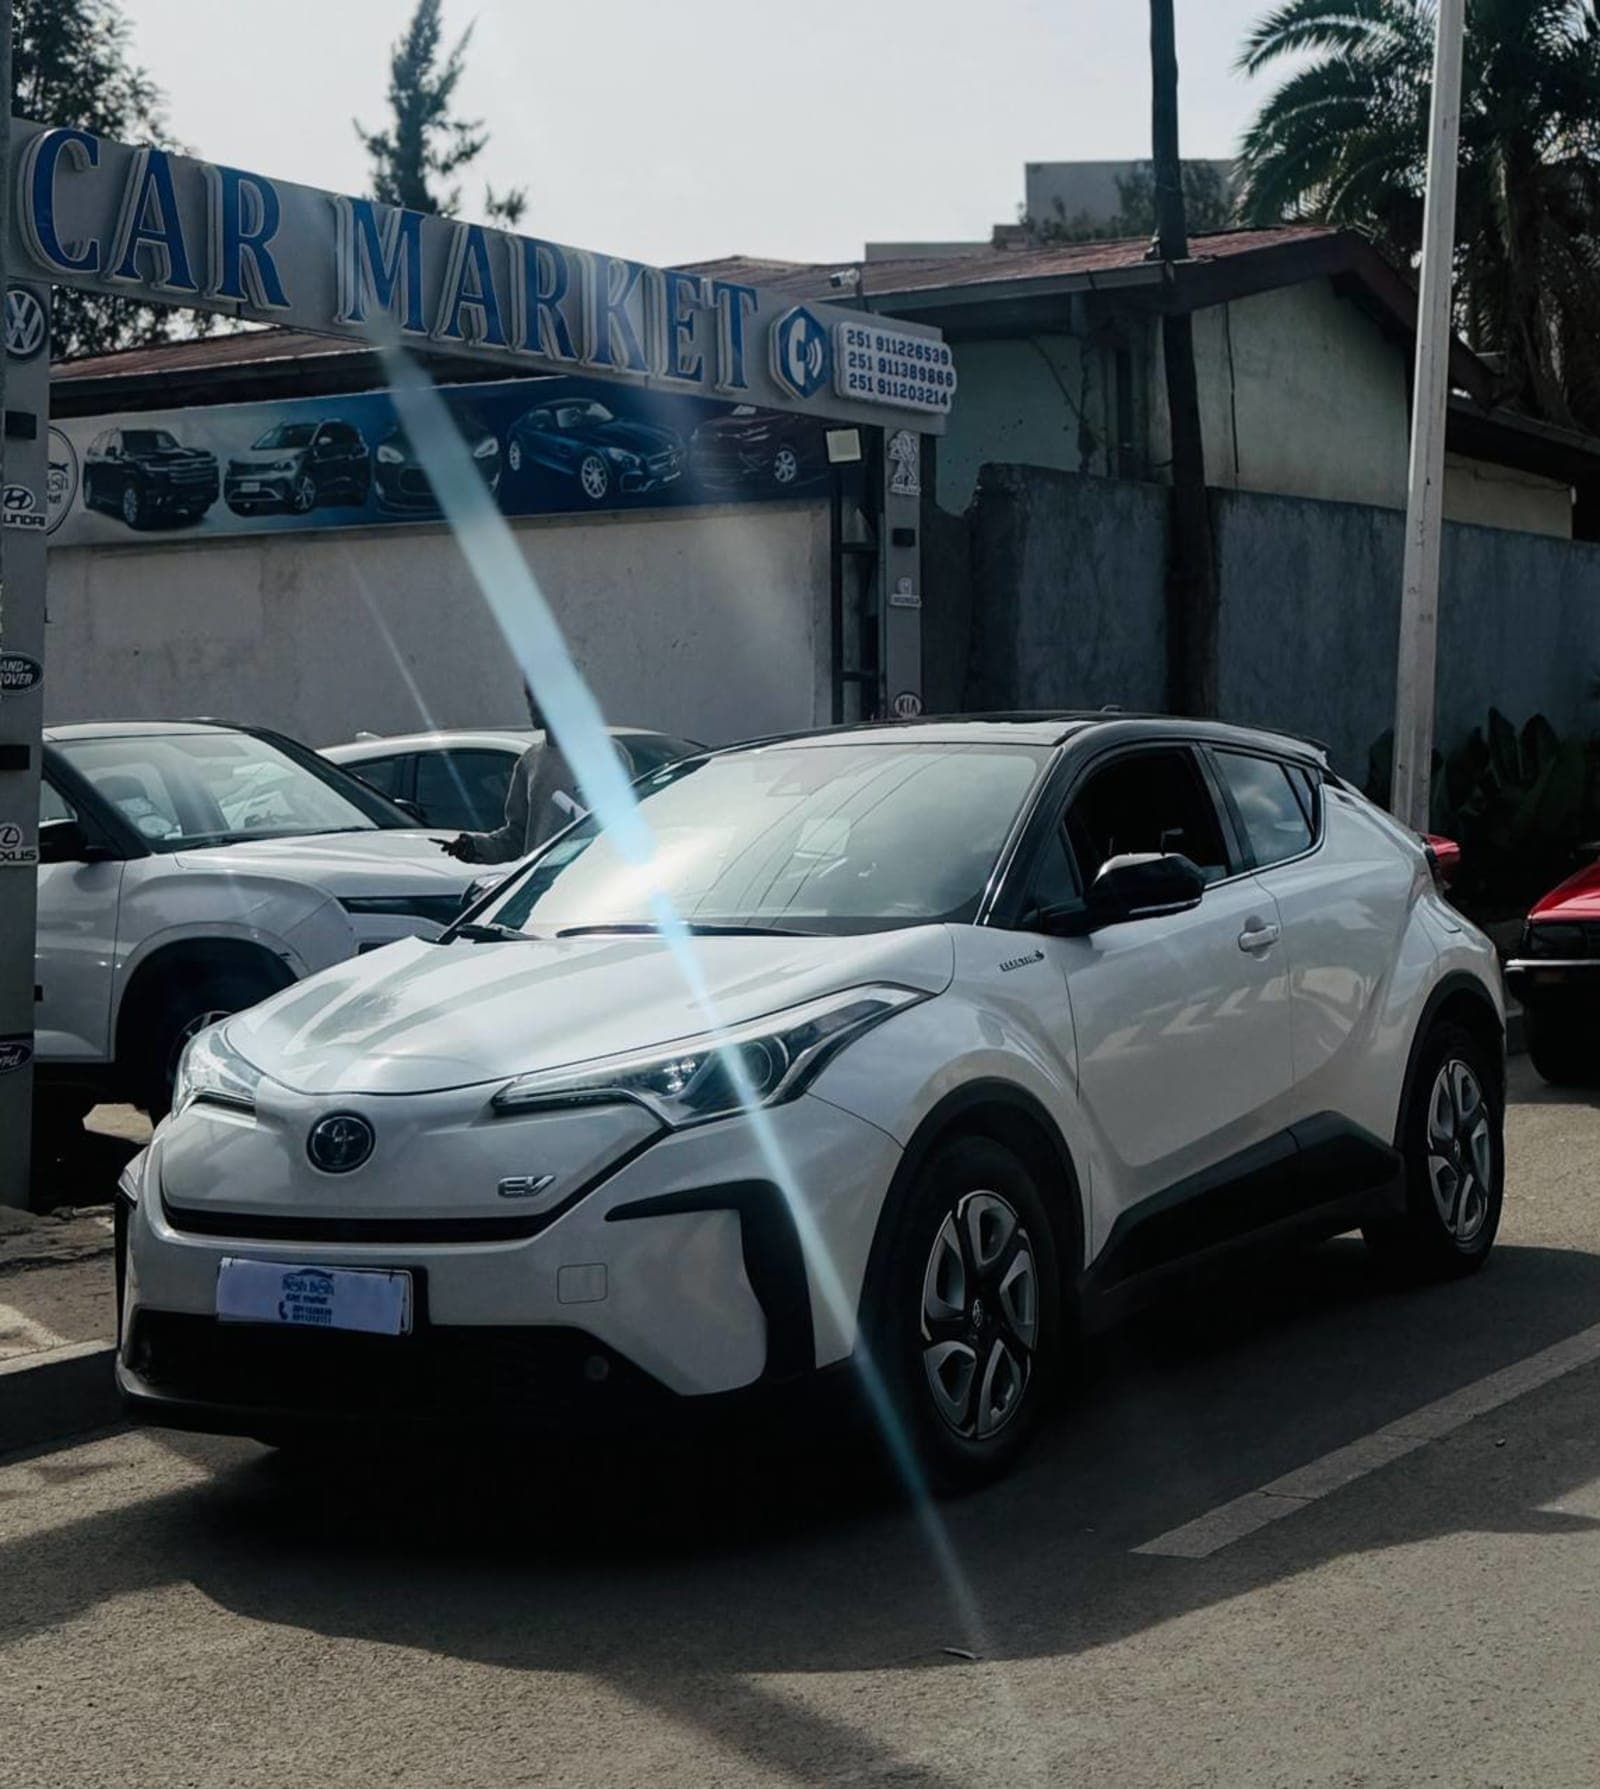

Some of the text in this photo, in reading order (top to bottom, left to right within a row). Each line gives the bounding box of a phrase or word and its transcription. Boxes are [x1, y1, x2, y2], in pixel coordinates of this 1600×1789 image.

[18, 127, 758, 395] CAR MARKET
[846, 329, 949, 366] 251 911226539
[848, 351, 873, 372] 251
[849, 372, 949, 406] 251 911203214
[3, 513, 46, 527] UNDAI
[0, 672, 33, 686] OVER
[898, 698, 918, 714] KIA
[0, 849, 37, 861] XUS
[497, 1174, 557, 1199] EV
